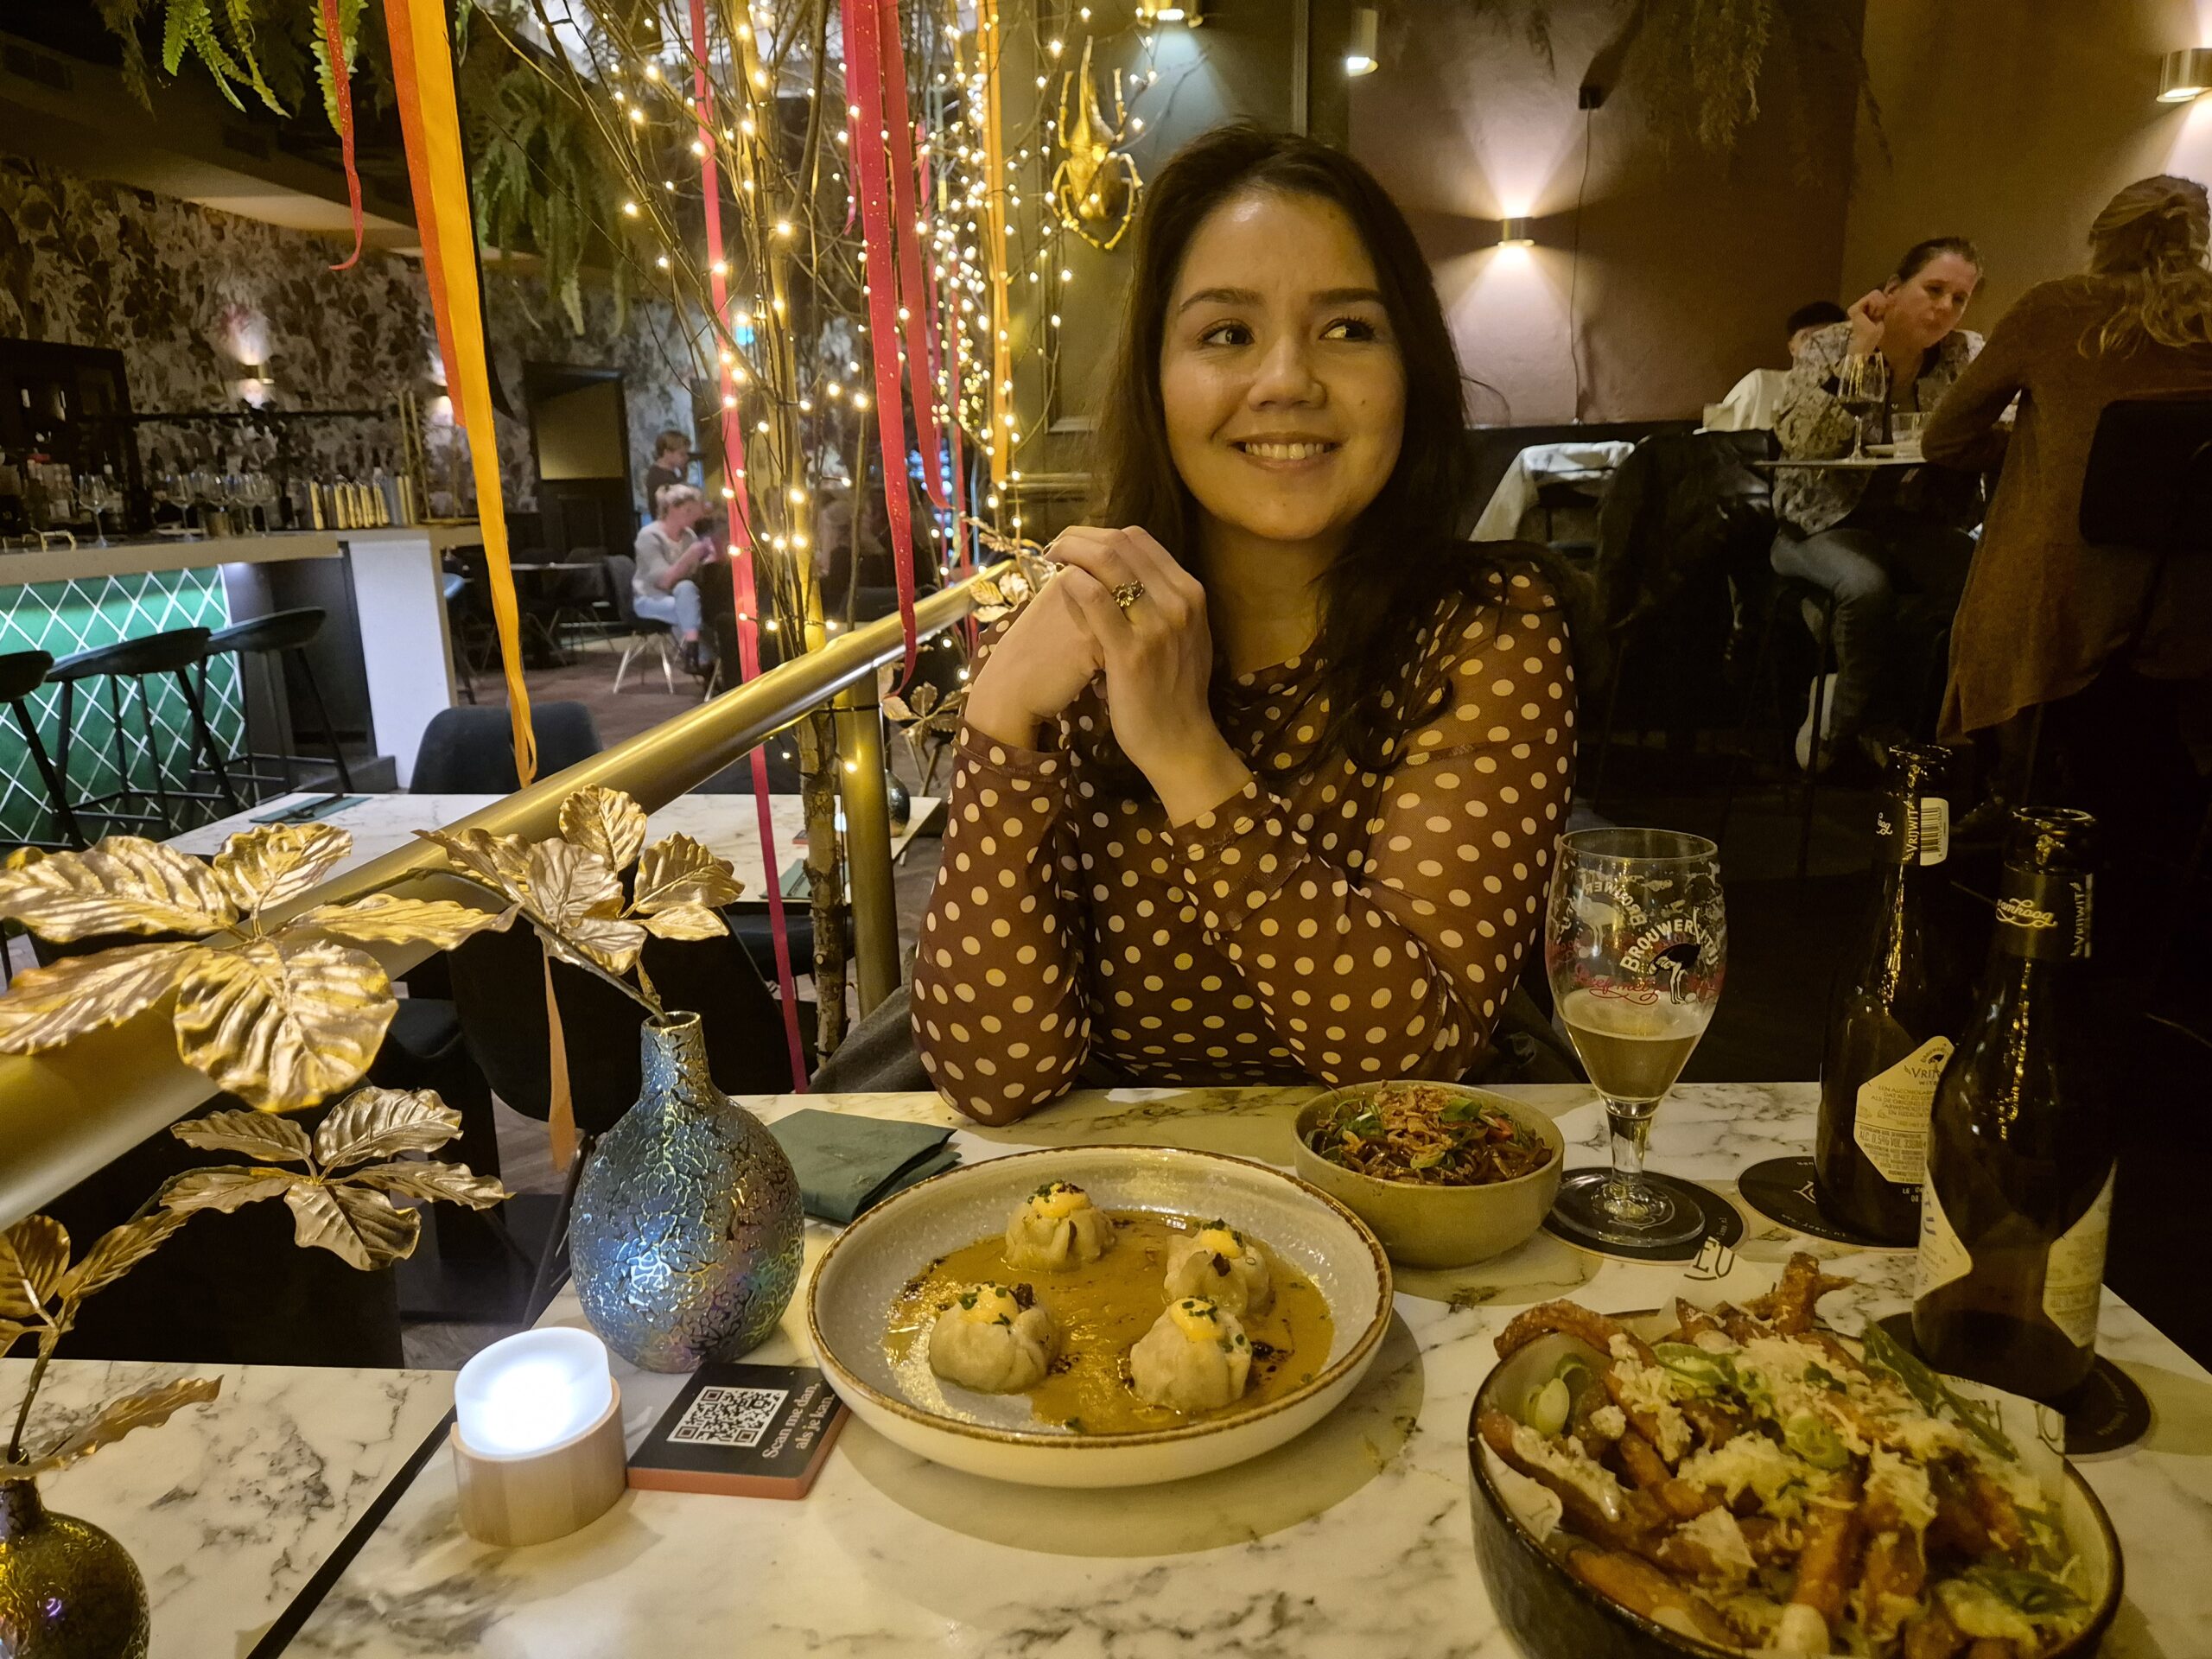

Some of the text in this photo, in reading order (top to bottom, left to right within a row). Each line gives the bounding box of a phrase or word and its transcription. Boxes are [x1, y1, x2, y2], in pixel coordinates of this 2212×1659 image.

[762, 1382, 821, 1459] Scan me dan,
[795, 1393, 836, 1450] als je kan.
